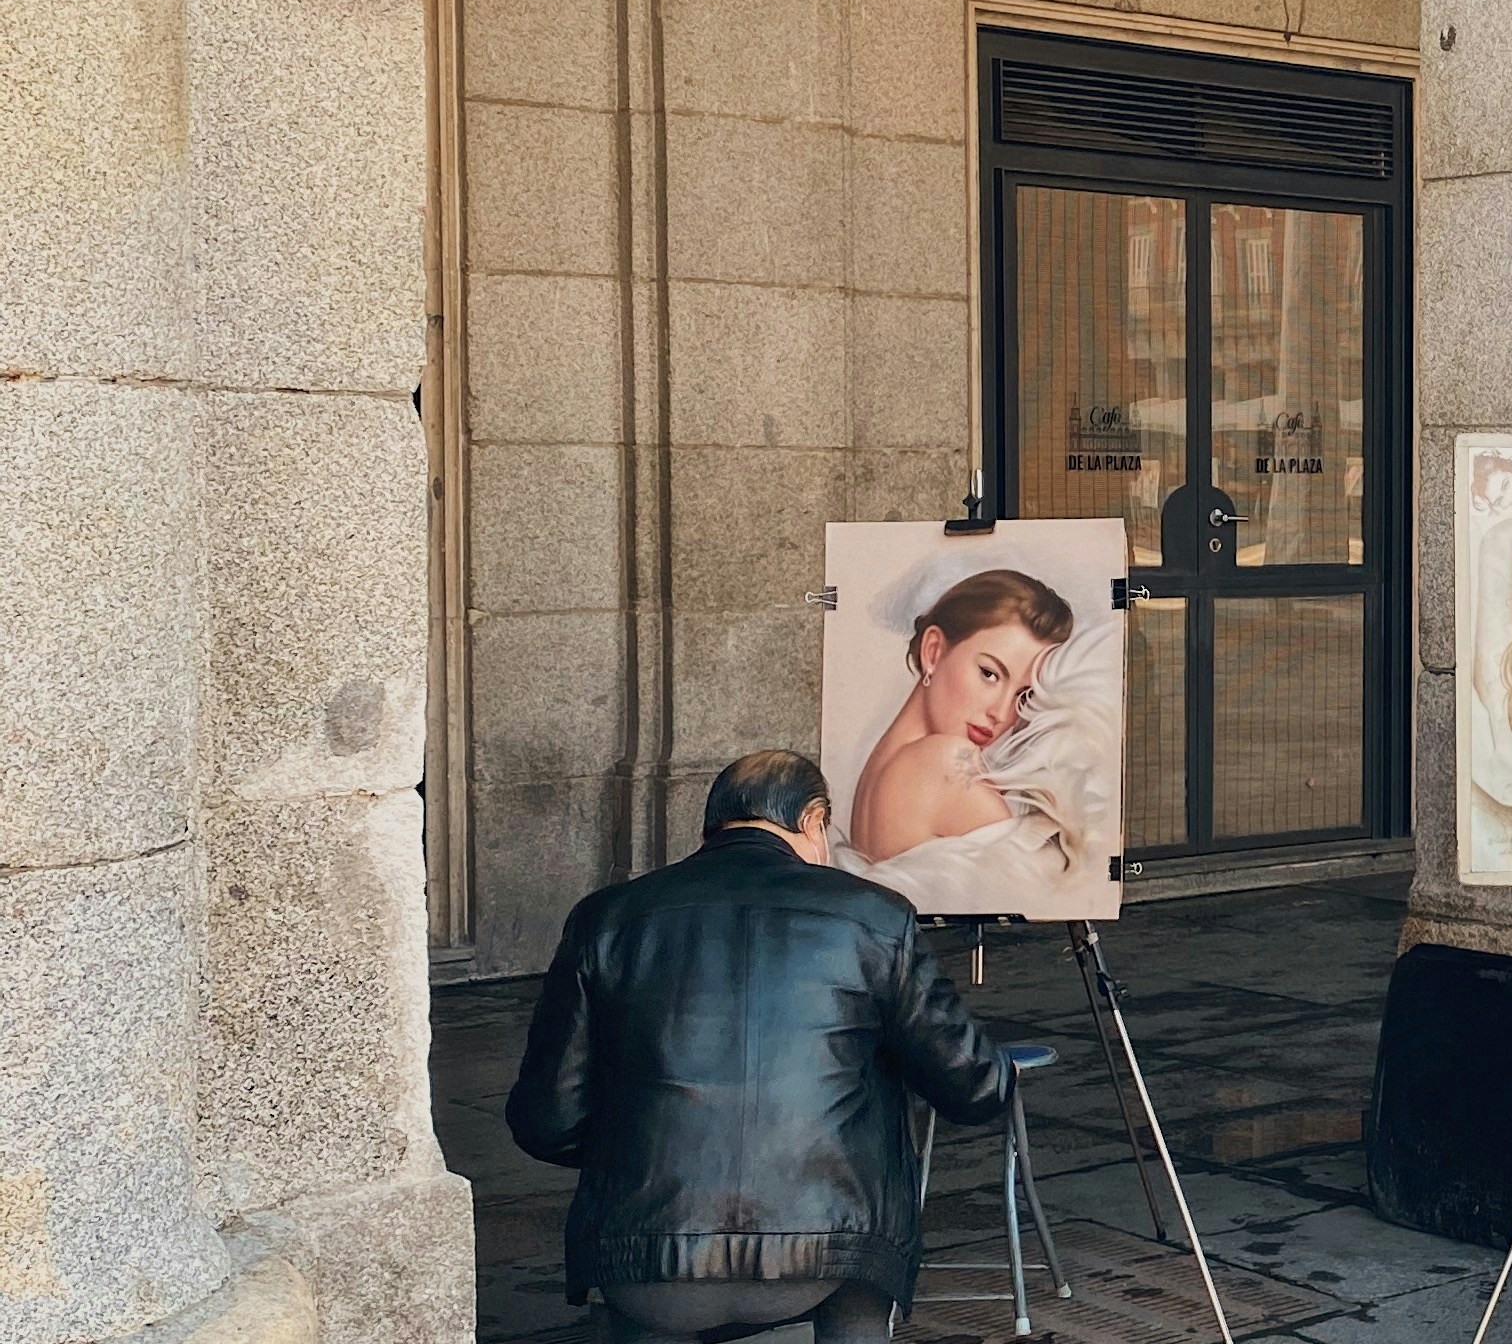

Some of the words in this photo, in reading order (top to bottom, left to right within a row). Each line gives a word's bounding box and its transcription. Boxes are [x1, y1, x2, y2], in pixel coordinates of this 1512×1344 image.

[1068, 455, 1084, 471] DE
[1087, 455, 1102, 471] LA
[1105, 455, 1142, 471] PLAZA
[1256, 458, 1270, 474] DE
[1273, 458, 1287, 474] LA
[1289, 458, 1324, 474] PLAZA
